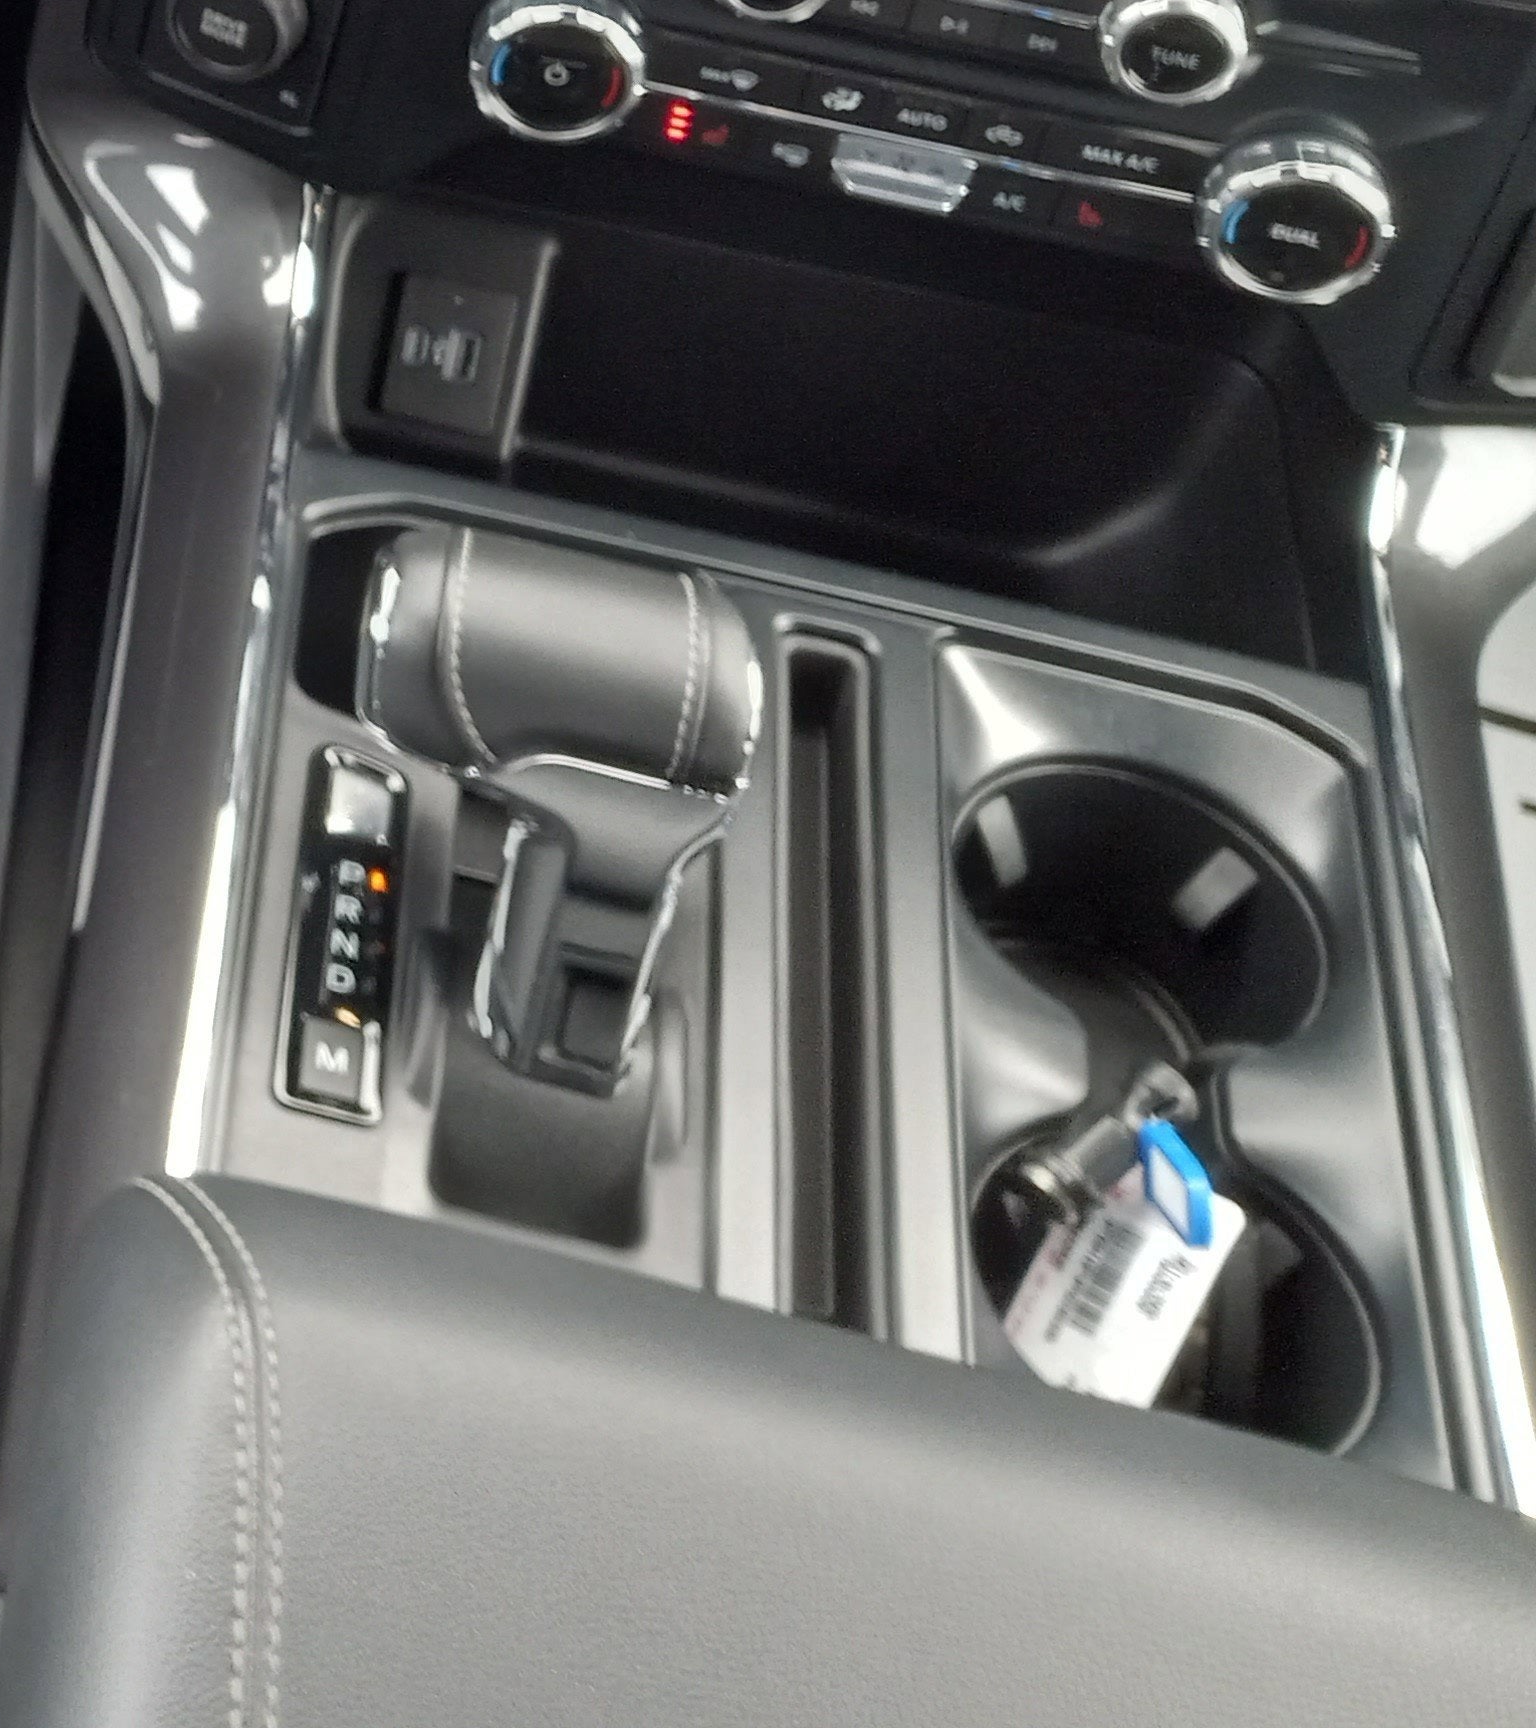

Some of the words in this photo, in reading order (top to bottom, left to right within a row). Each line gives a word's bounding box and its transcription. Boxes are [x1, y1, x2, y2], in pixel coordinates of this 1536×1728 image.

[1152, 46, 1200, 69] TUNE
[898, 109, 947, 131] AUTO
[1082, 145, 1122, 166] MAX
[331, 928, 359, 961] N
[327, 963, 355, 993] D
[315, 1041, 348, 1073] M
